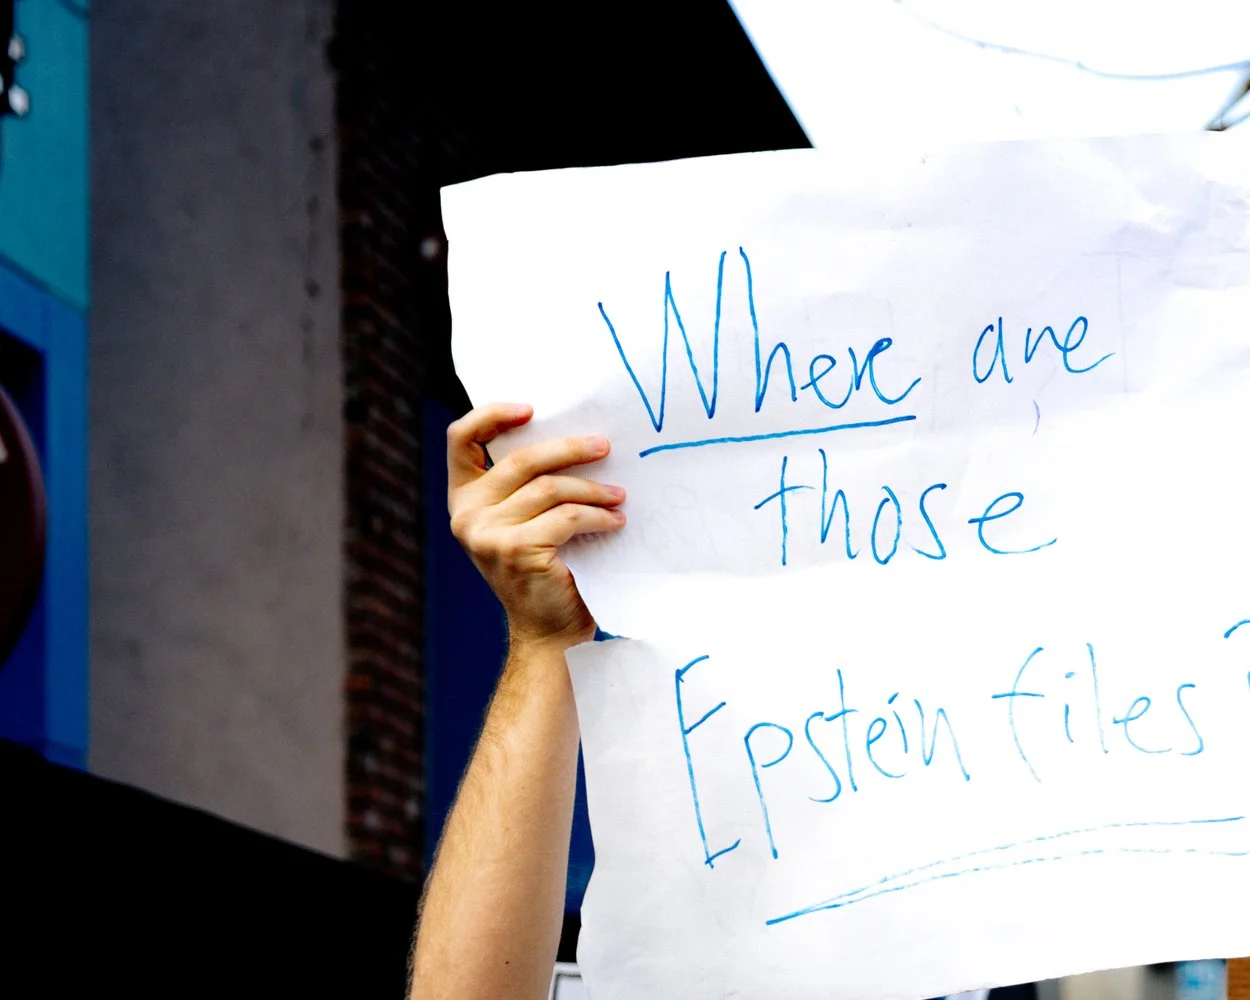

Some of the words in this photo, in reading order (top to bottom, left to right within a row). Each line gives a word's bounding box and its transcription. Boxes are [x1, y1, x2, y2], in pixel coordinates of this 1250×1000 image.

[598, 246, 921, 432] Where
[972, 315, 1116, 385] are
[754, 449, 1057, 565] those
[674, 654, 970, 868] Epstein
